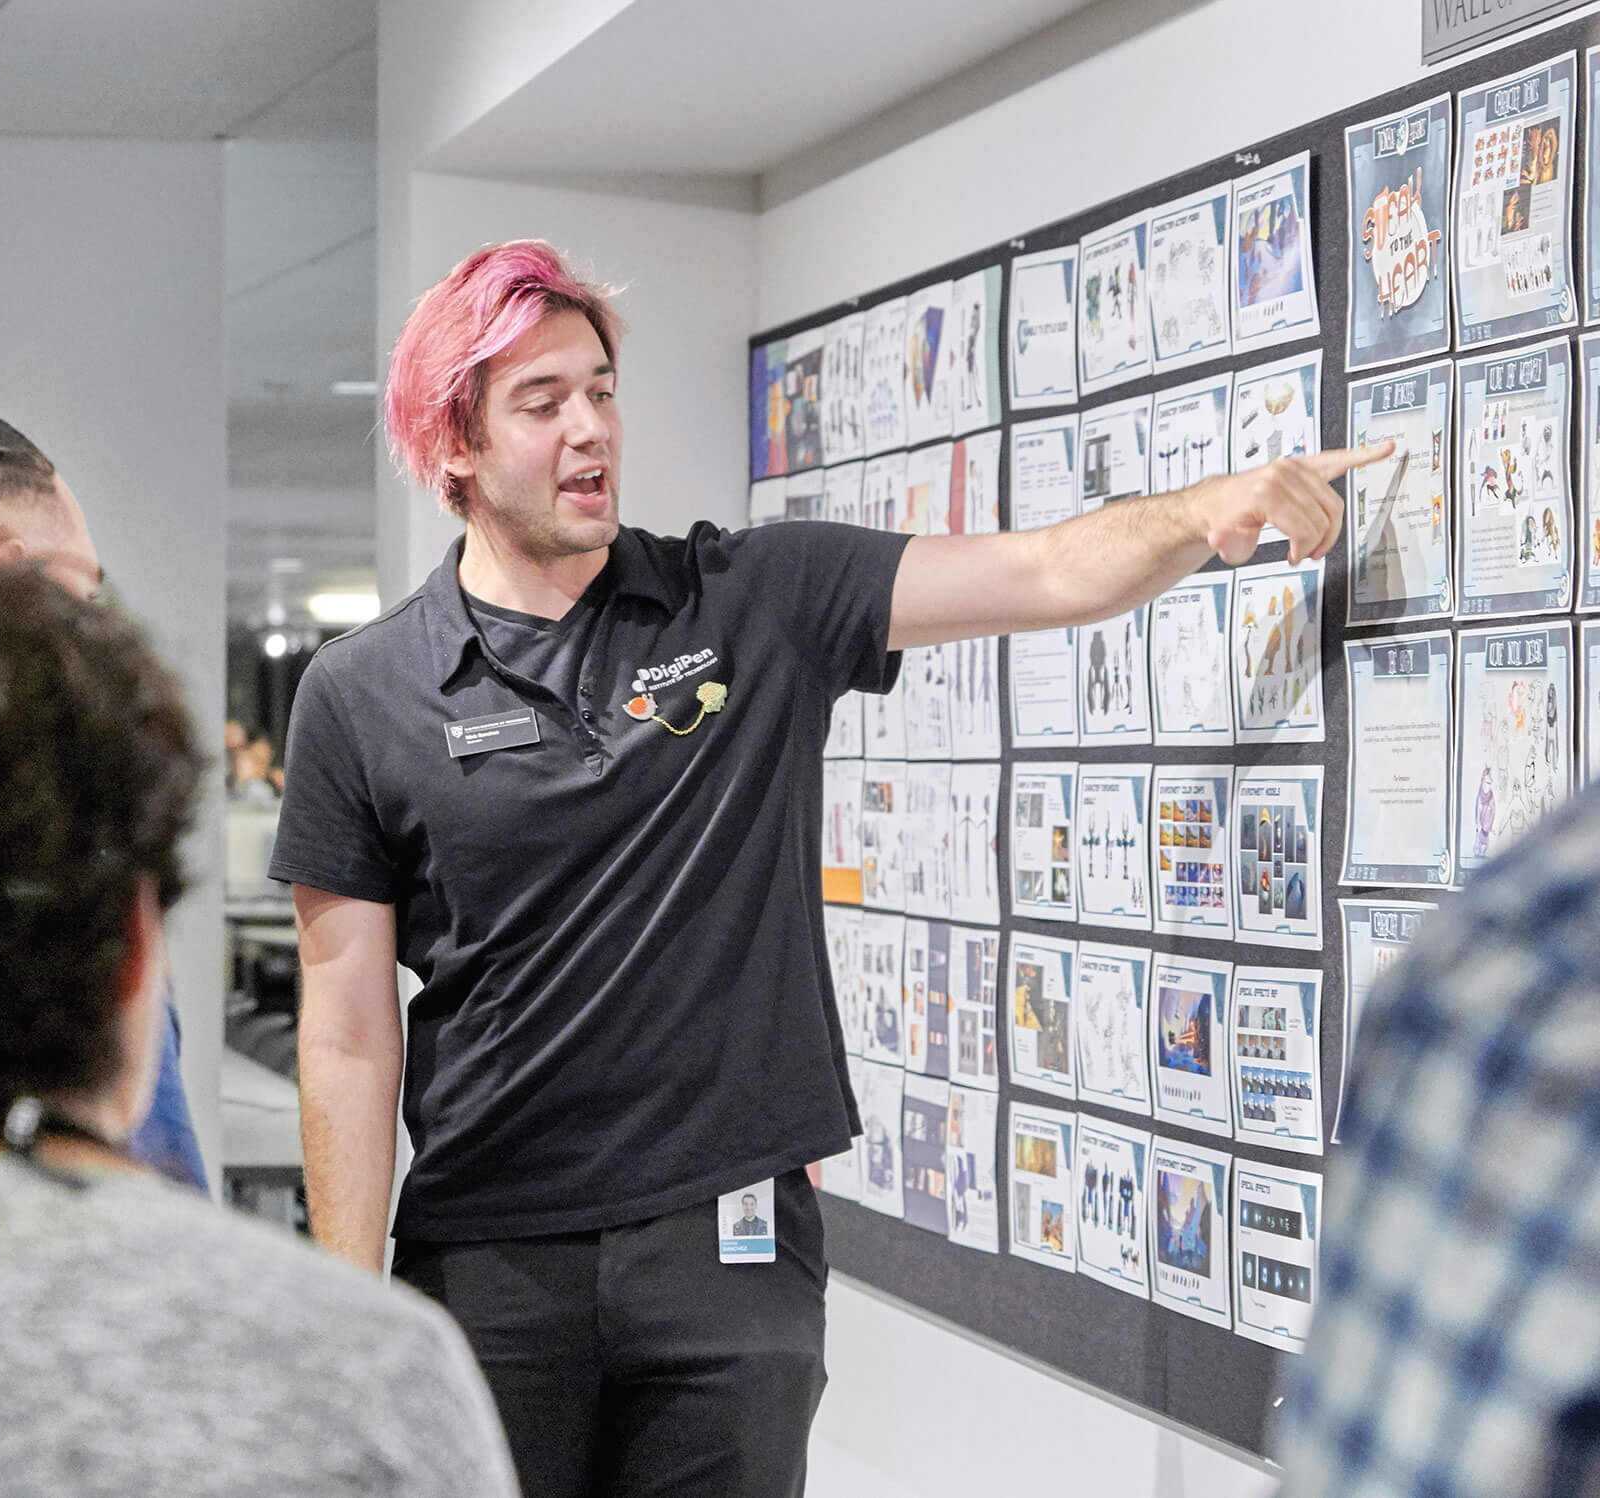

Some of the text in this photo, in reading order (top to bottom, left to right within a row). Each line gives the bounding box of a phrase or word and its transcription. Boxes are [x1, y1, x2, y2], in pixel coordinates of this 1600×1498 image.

[1433, 0, 1492, 33] WAL
[1362, 166, 1422, 261] STEAK
[1390, 229, 1413, 256] TO THE
[1377, 229, 1442, 319] HEART
[649, 648, 714, 681] DigiPen
